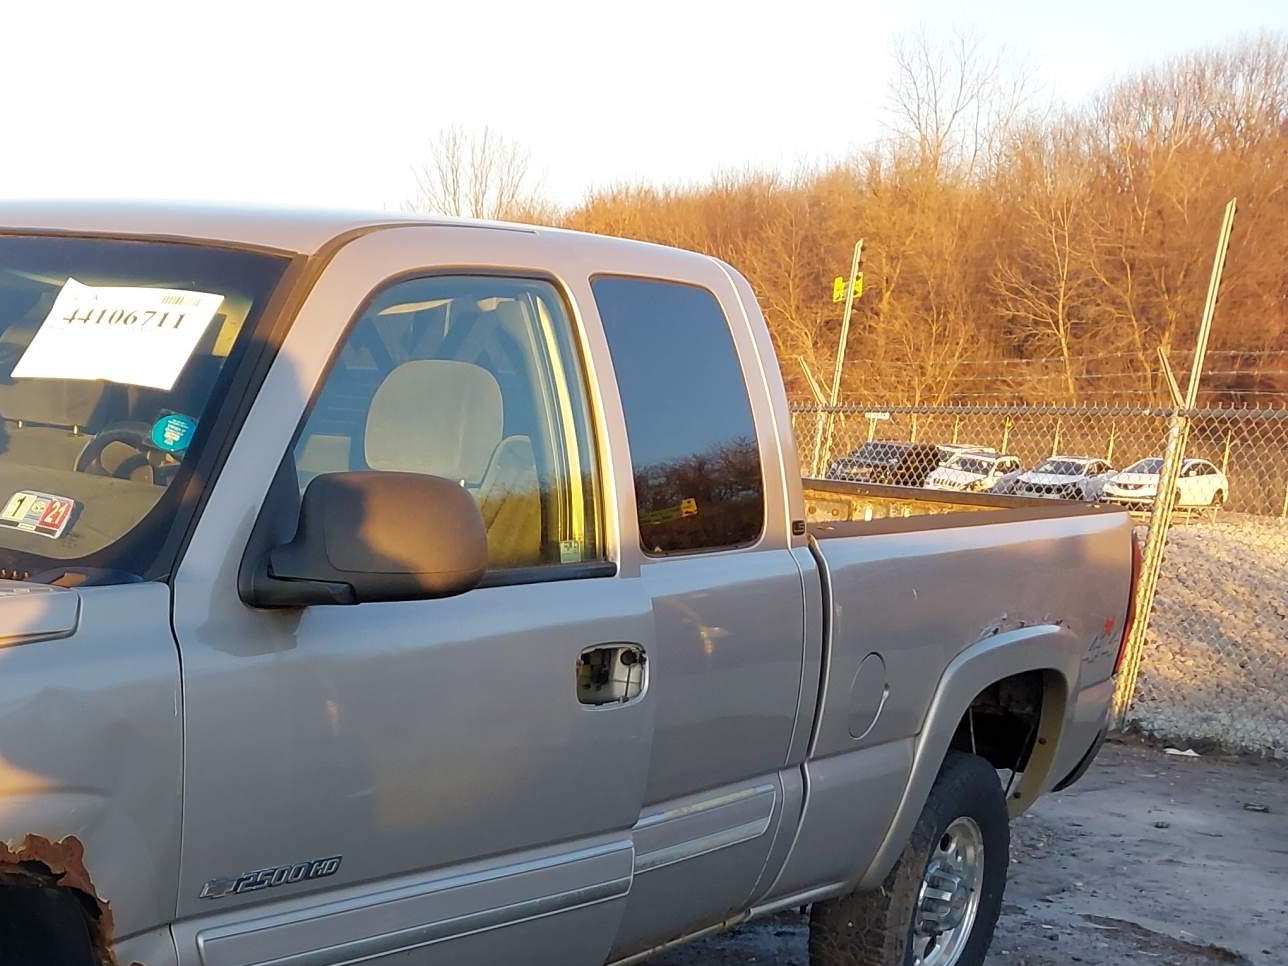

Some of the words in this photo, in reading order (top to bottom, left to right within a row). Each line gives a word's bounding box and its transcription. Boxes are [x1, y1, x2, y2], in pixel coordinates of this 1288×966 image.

[62, 307, 187, 330] 44106711
[11, 495, 27, 518] 1
[44, 502, 69, 525] 21
